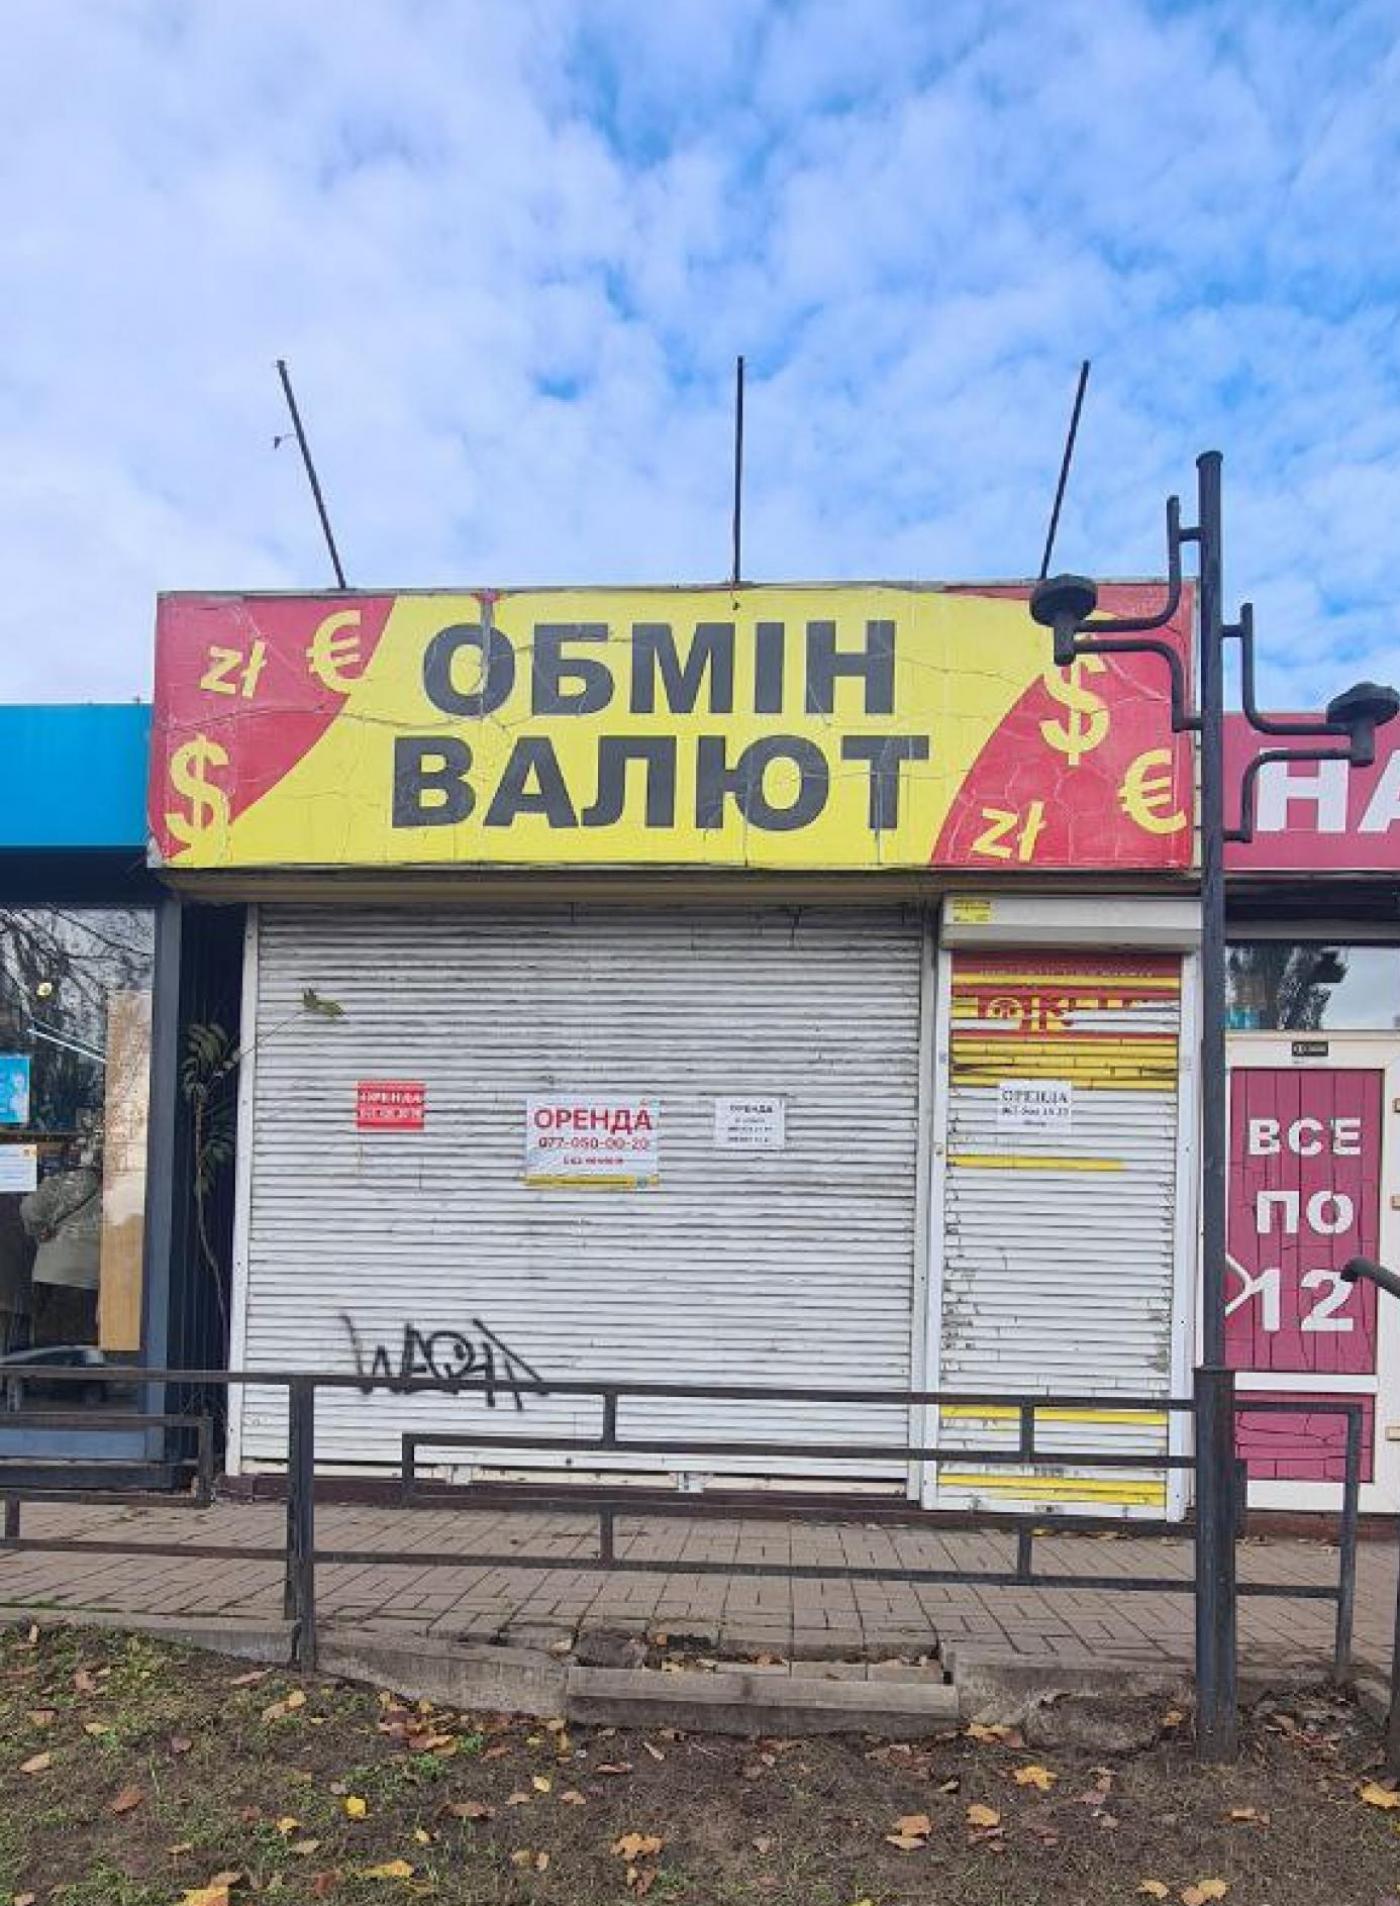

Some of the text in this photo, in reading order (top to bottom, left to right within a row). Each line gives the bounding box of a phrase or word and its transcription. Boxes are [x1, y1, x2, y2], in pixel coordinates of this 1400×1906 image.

[422, 619, 897, 718] ОБМІН
[391, 733, 930, 832] ВАЛЮТ
[533, 1108, 654, 1135] ОРЕНДА
[1248, 1117, 1362, 1157] ВСЕ
[1255, 1189, 1355, 1235] ПО
